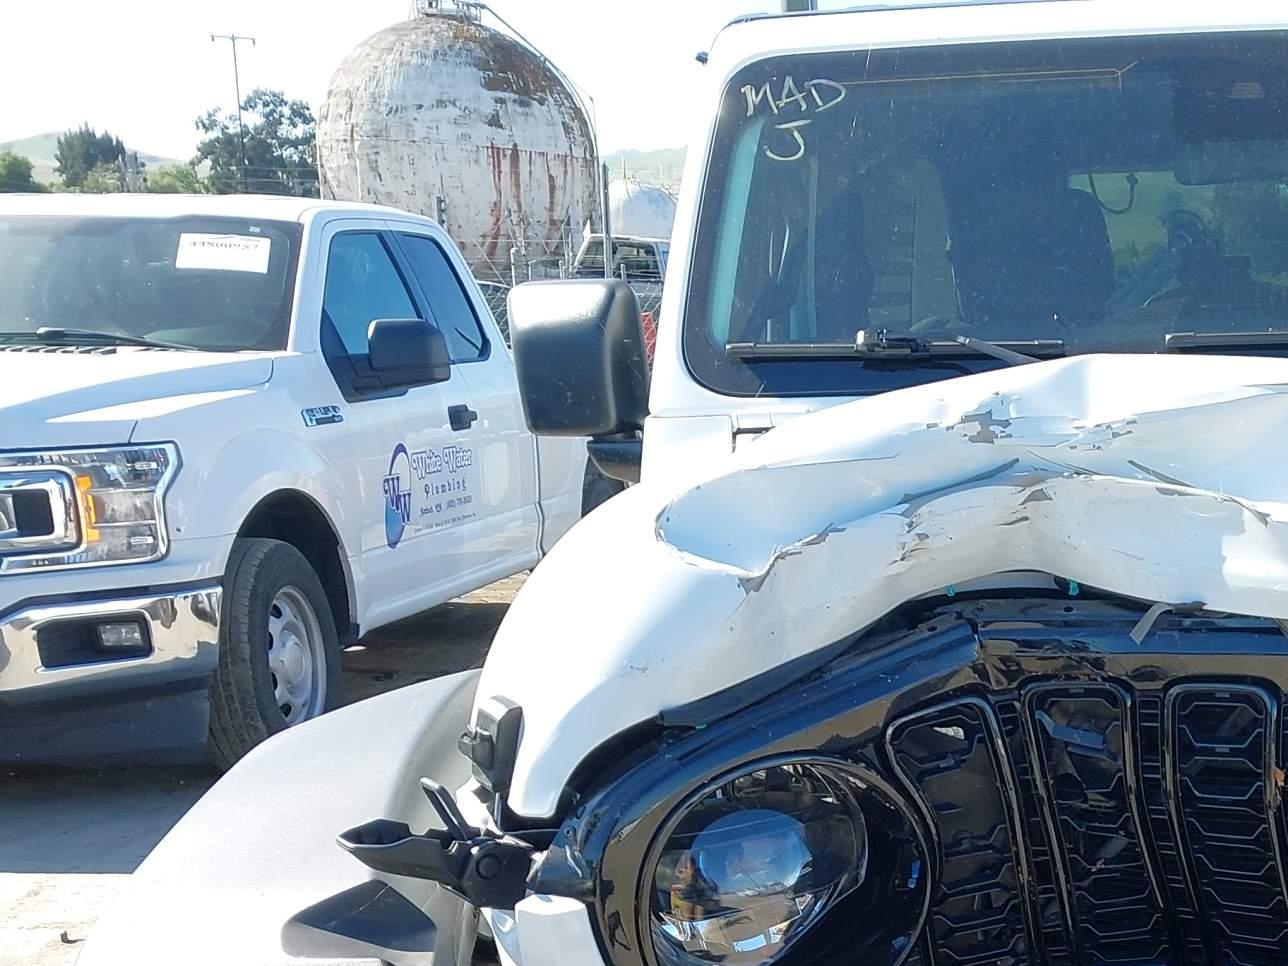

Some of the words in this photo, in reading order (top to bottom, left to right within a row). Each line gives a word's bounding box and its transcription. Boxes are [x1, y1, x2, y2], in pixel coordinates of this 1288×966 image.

[741, 76, 846, 117] MAD
[763, 119, 812, 161] J
[411, 449, 442, 480] White
[443, 446, 472, 473] Water
[424, 478, 466, 499] Plumbing
